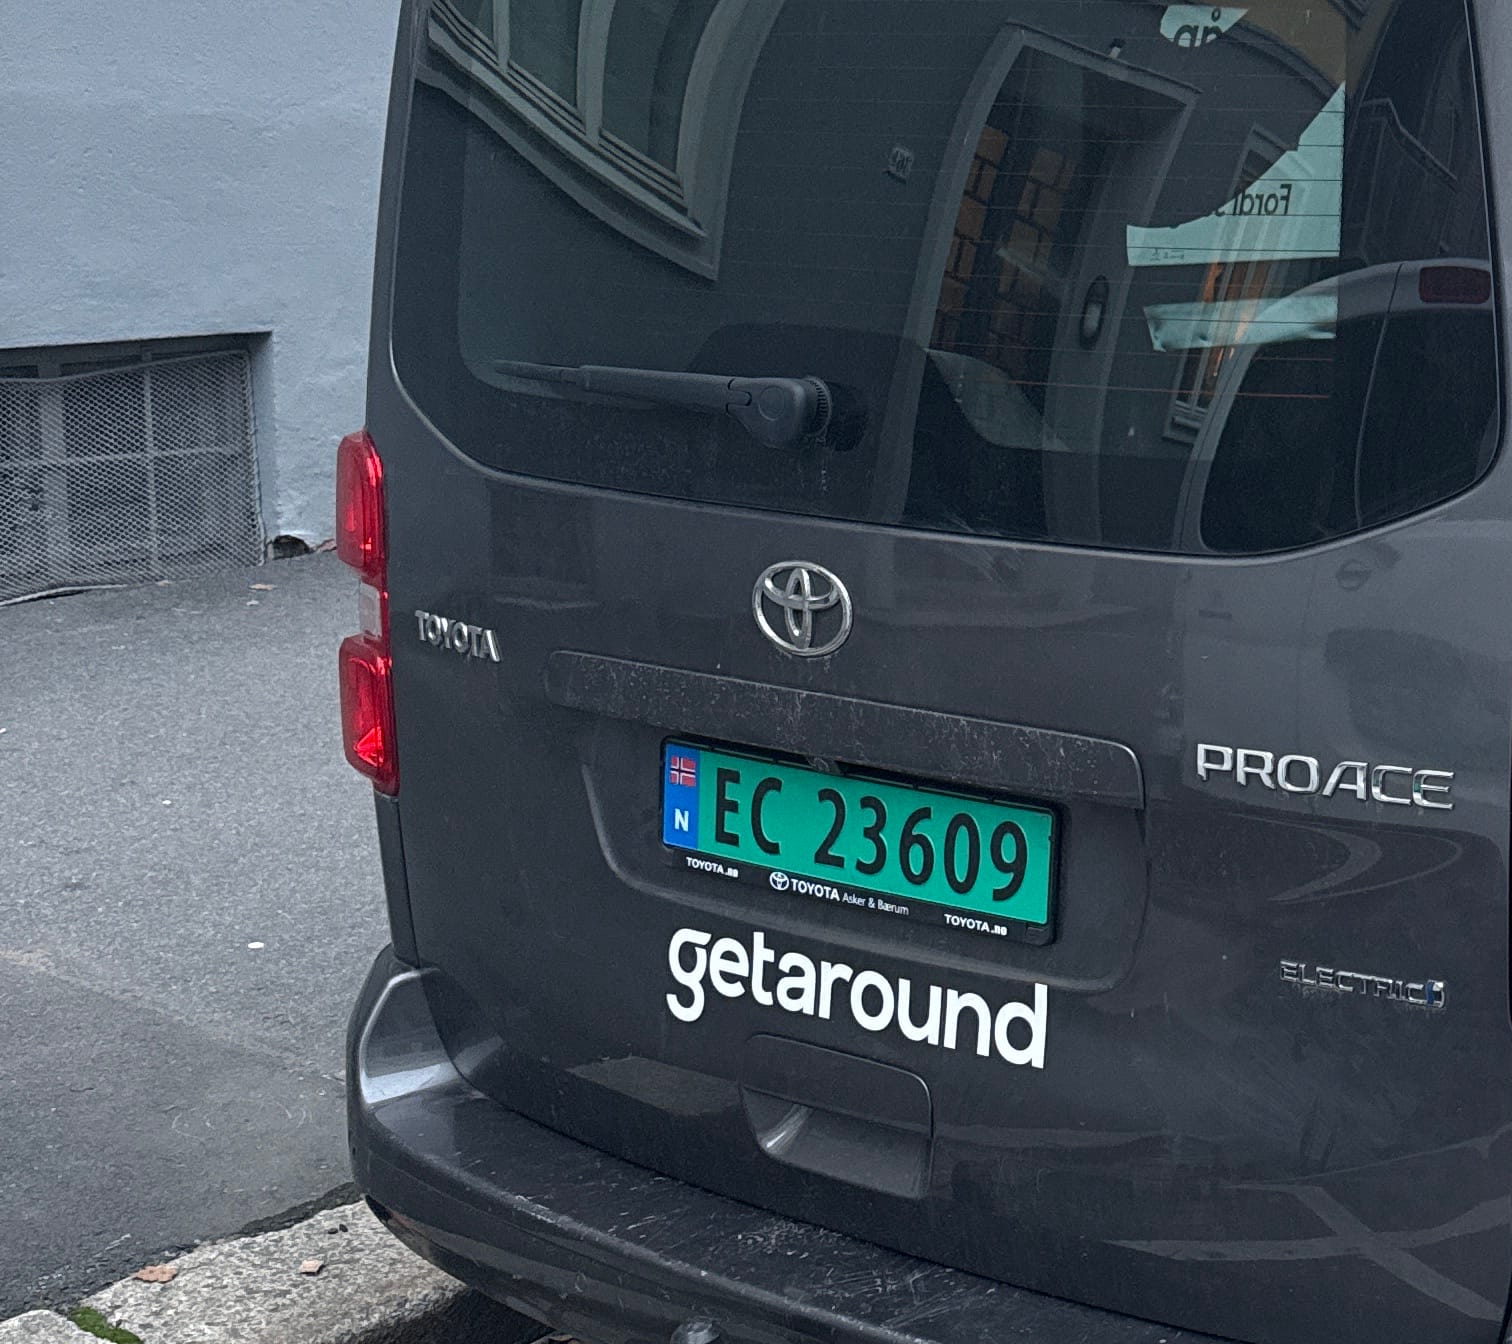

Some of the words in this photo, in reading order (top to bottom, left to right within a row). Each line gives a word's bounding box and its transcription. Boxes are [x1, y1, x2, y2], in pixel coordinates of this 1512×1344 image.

[415, 610, 500, 662] TOYOTA
[1197, 743, 1454, 809] PROACE
[674, 808, 690, 833] N
[714, 766, 783, 855] EC
[814, 788, 1029, 902] 23609
[791, 878, 840, 901] TOYOTA
[842, 892, 866, 907] Asker
[868, 897, 876, 909] &
[877, 899, 909, 916] Bærum
[666, 927, 1048, 1069] getaround
[1280, 960, 1424, 1005] ELECTRIC
